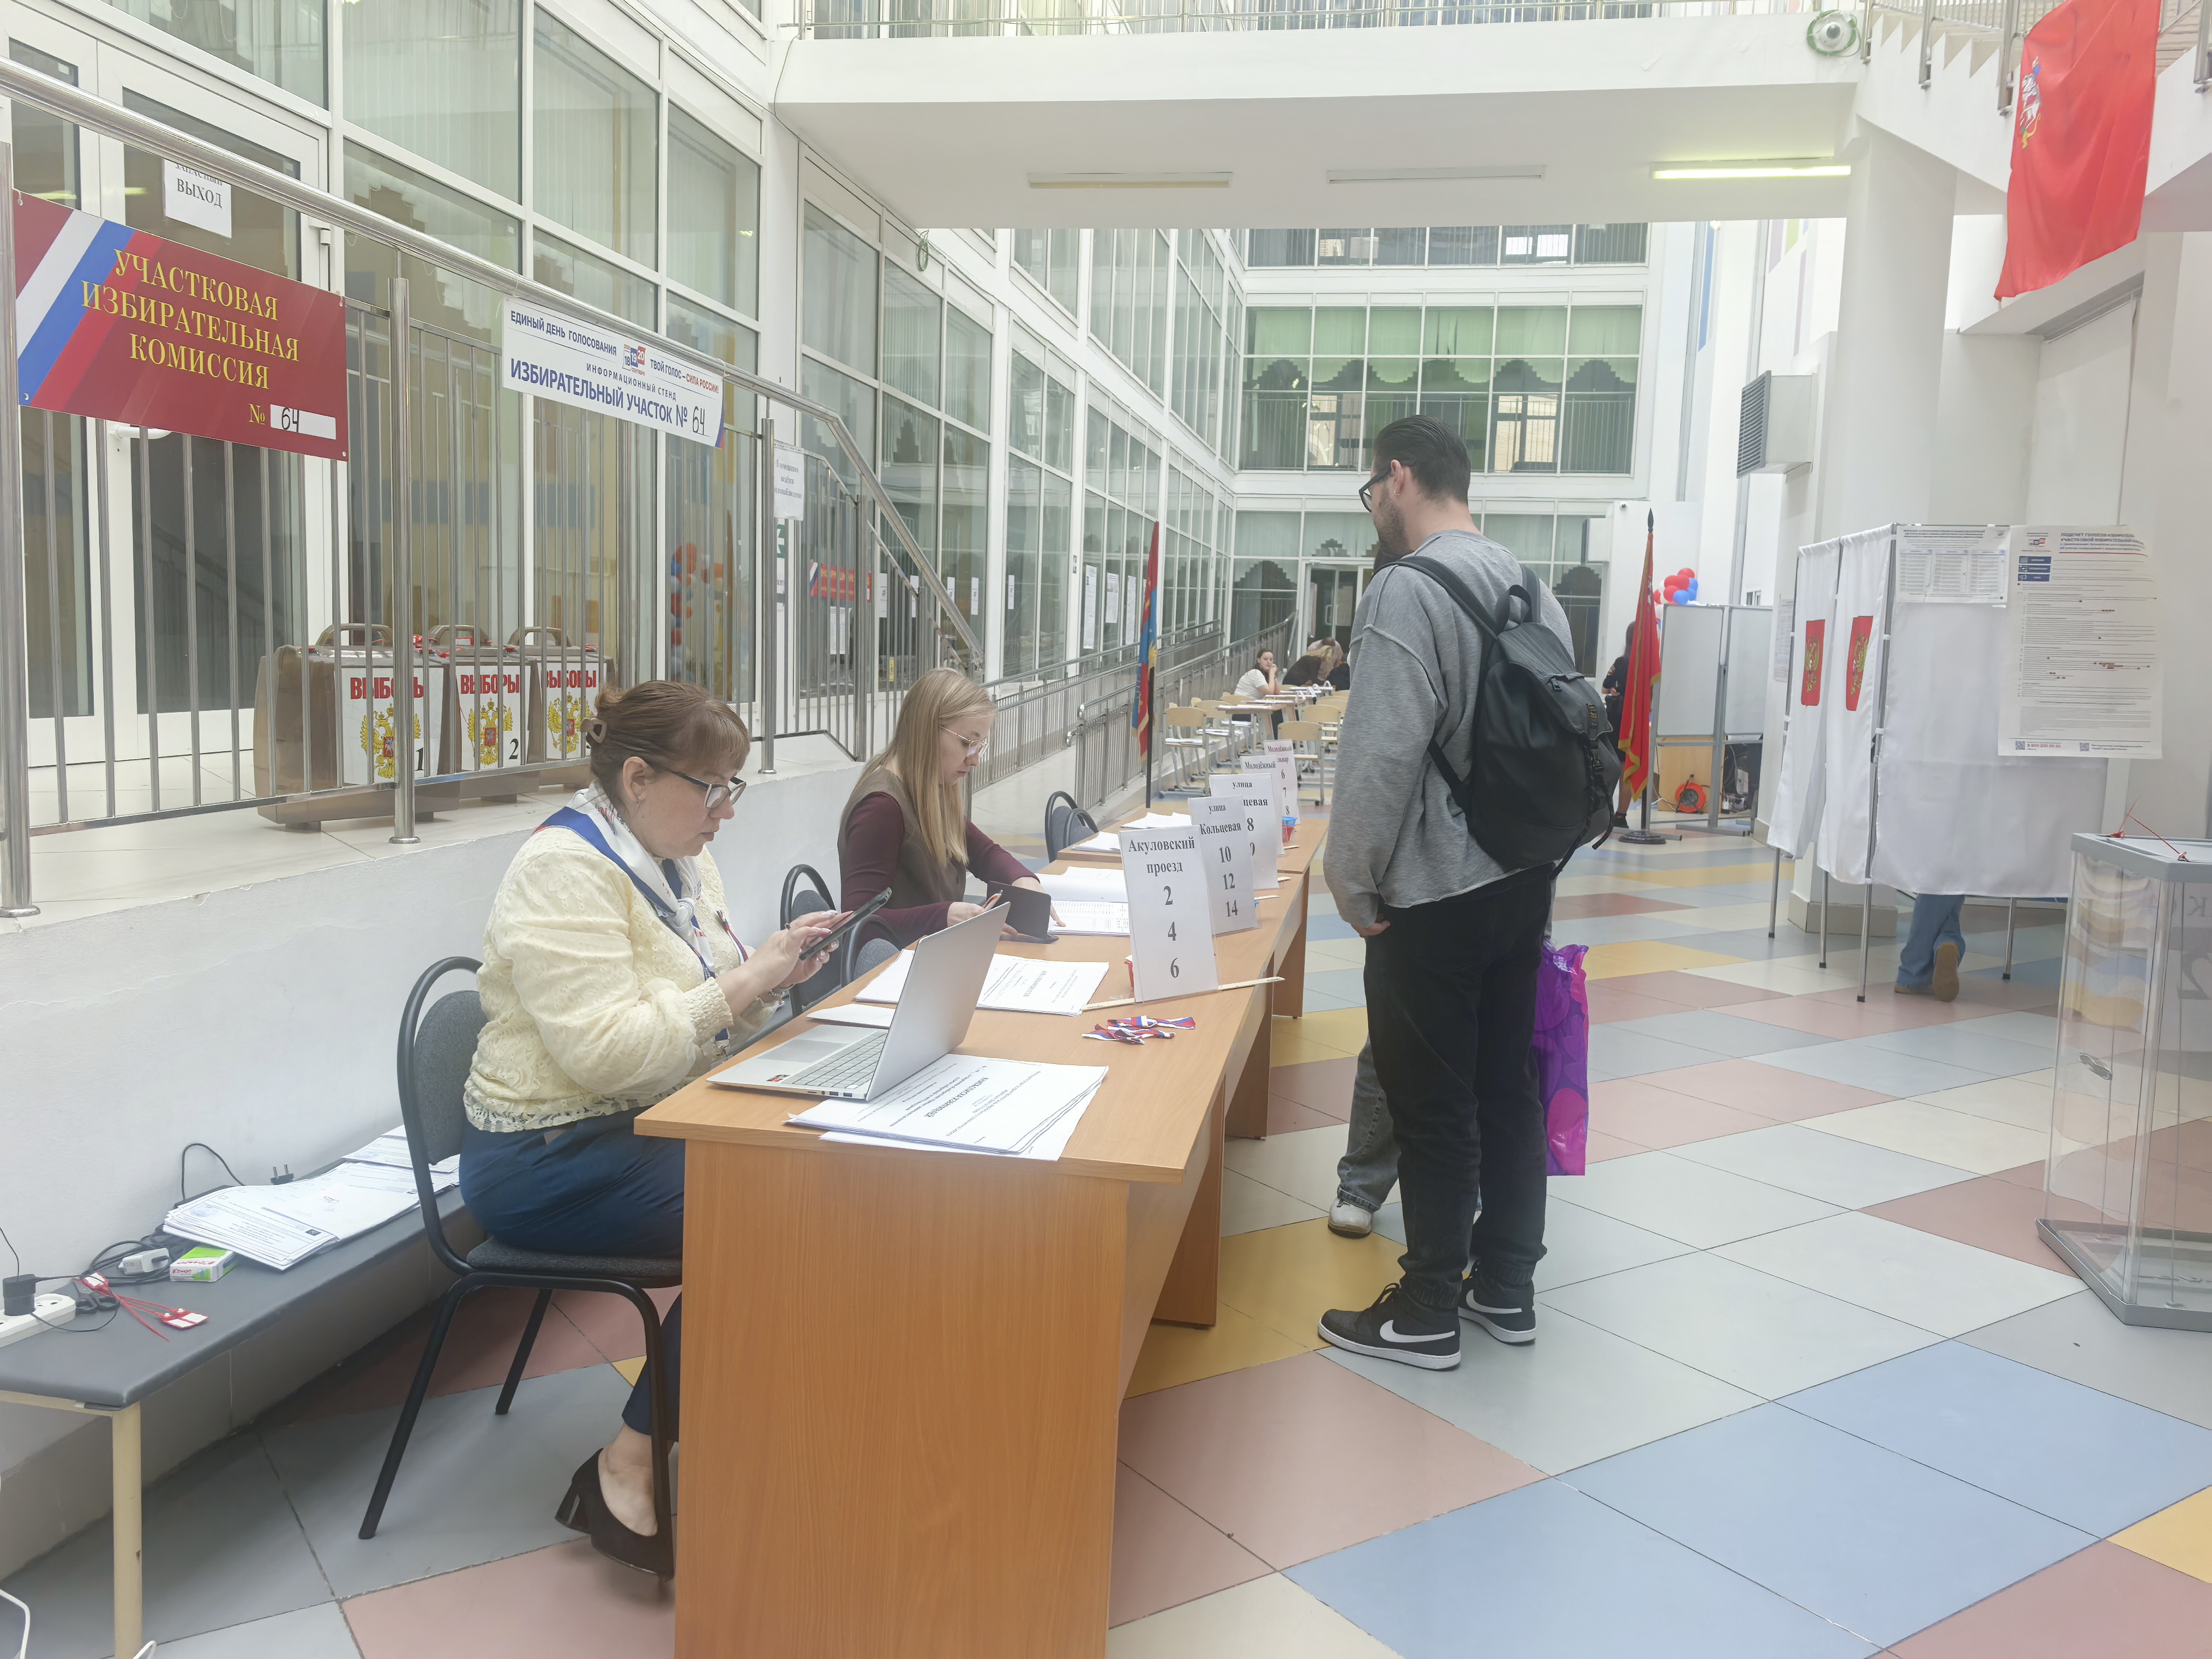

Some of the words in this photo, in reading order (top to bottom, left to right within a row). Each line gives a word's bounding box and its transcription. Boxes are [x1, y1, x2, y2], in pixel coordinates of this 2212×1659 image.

[177, 178, 222, 210] ВЫХОД
[113, 249, 279, 320] УЧАСТКОВАЯ
[82, 281, 299, 362] ИЗБИРАТЕЛЬНАЯ
[511, 310, 544, 331] ЕДИНЫЙ
[546, 322, 565, 338] ДЕНЬ
[569, 331, 617, 356] ГОЛОСОВАНИЯ
[130, 333, 269, 390] КОМИССИЯ
[625, 356, 630, 366] 18
[631, 353, 637, 363] 19
[637, 350, 644, 361] 20
[650, 359, 665, 373] ТВОЙ
[665, 365, 682, 379] ГОЛОС
[686, 374, 699, 386] СИЛА
[586, 363, 656, 393] ИНФОРМАЦИОННЫЙ
[658, 387, 676, 401] СТЕНД
[511, 358, 624, 408] ИЗБИРАТЕЛЬНЫЙ
[627, 393, 672, 424] УЧАСТОК
[676, 404, 687, 427] №
[692, 406, 705, 435] 64
[248, 403, 265, 425] №
[281, 408, 300, 433] 64
[350, 677, 424, 699] ВЫБЫ
[542, 670, 596, 688] ЫОРЫ
[509, 738, 519, 759] 2
[415, 747, 424, 771] 1
[1245, 761, 1276, 770] Молодёжный
[1281, 769, 1285, 779] 6
[1283, 787, 1286, 798] 7
[1208, 805, 1226, 814] улица
[1243, 798, 1268, 807] цевая
[1285, 805, 1290, 815] 8
[1199, 823, 1241, 835] Кольцевая
[1247, 817, 1255, 831] 8
[1128, 836, 1196, 852] Акуловский
[1219, 846, 1232, 863] 10
[1147, 861, 1183, 876] проезд
[1223, 873, 1235, 890] 12
[1163, 886, 1173, 906] 2
[1226, 899, 1238, 918] 14
[1168, 921, 1177, 941] 4
[1170, 957, 1179, 978] 6
